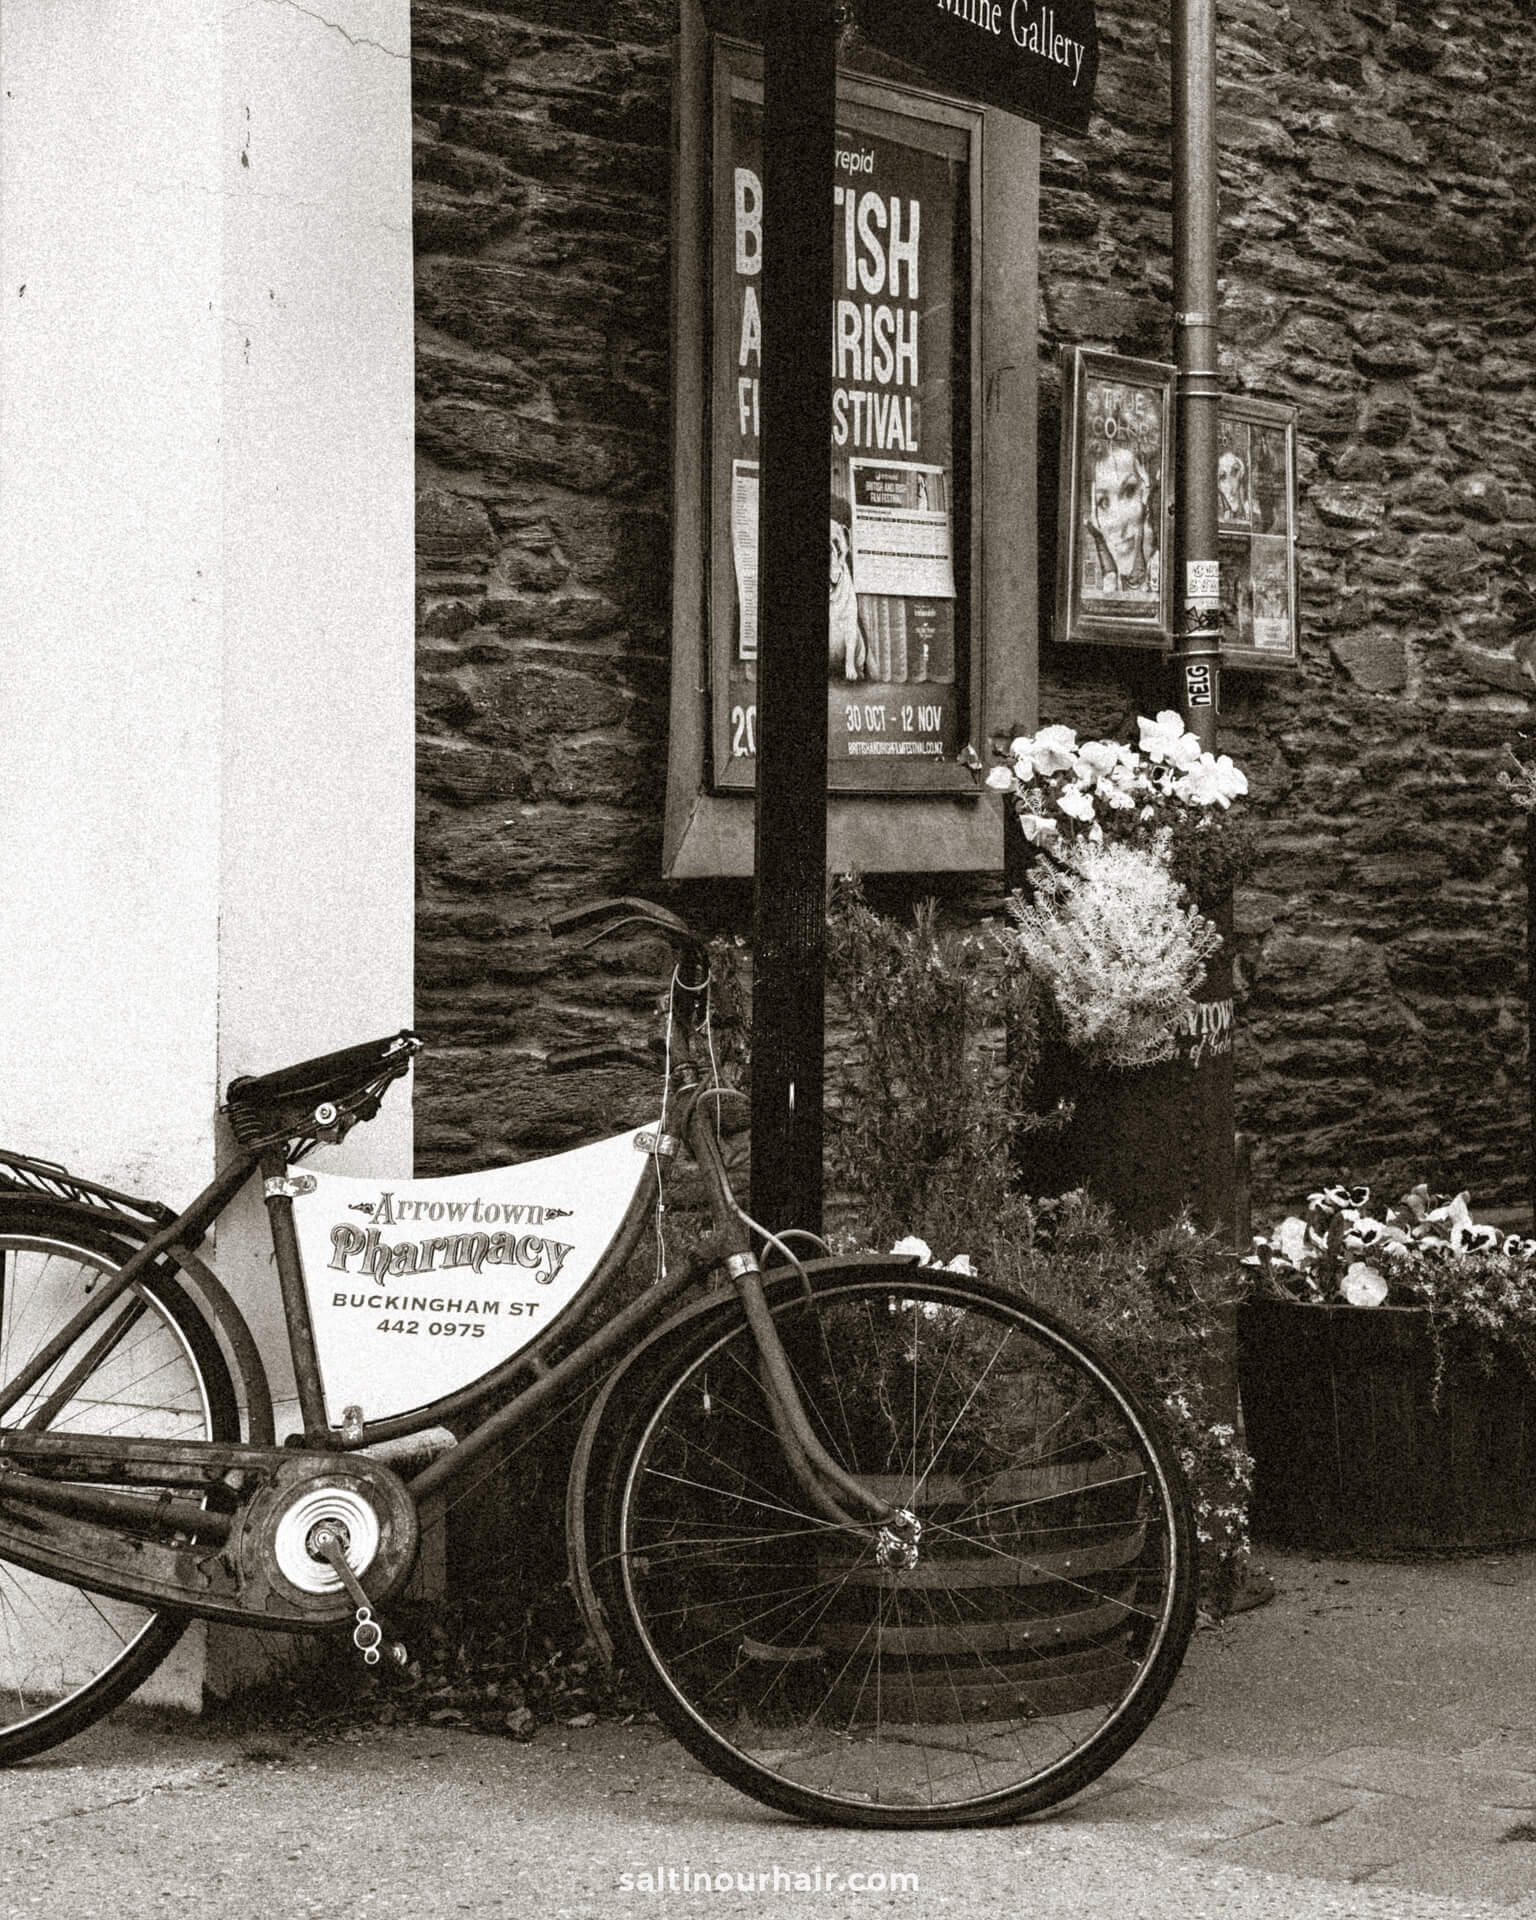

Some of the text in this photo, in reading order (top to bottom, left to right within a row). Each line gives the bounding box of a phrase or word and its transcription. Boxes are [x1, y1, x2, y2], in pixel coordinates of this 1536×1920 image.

[1011, 0, 1085, 87] Gallery
[834, 147, 875, 176] repid
[831, 387, 919, 452] STIVAL
[846, 705, 862, 732] 30
[865, 704, 886, 732] OCT
[901, 705, 913, 732] 12
[918, 706, 942, 732] NOV
[369, 1191, 545, 1225] Arrowtown
[327, 1222, 576, 1287] Pharmacy
[331, 1292, 541, 1317] BUCKINGHAM ST
[376, 1319, 486, 1338] 442 0975
